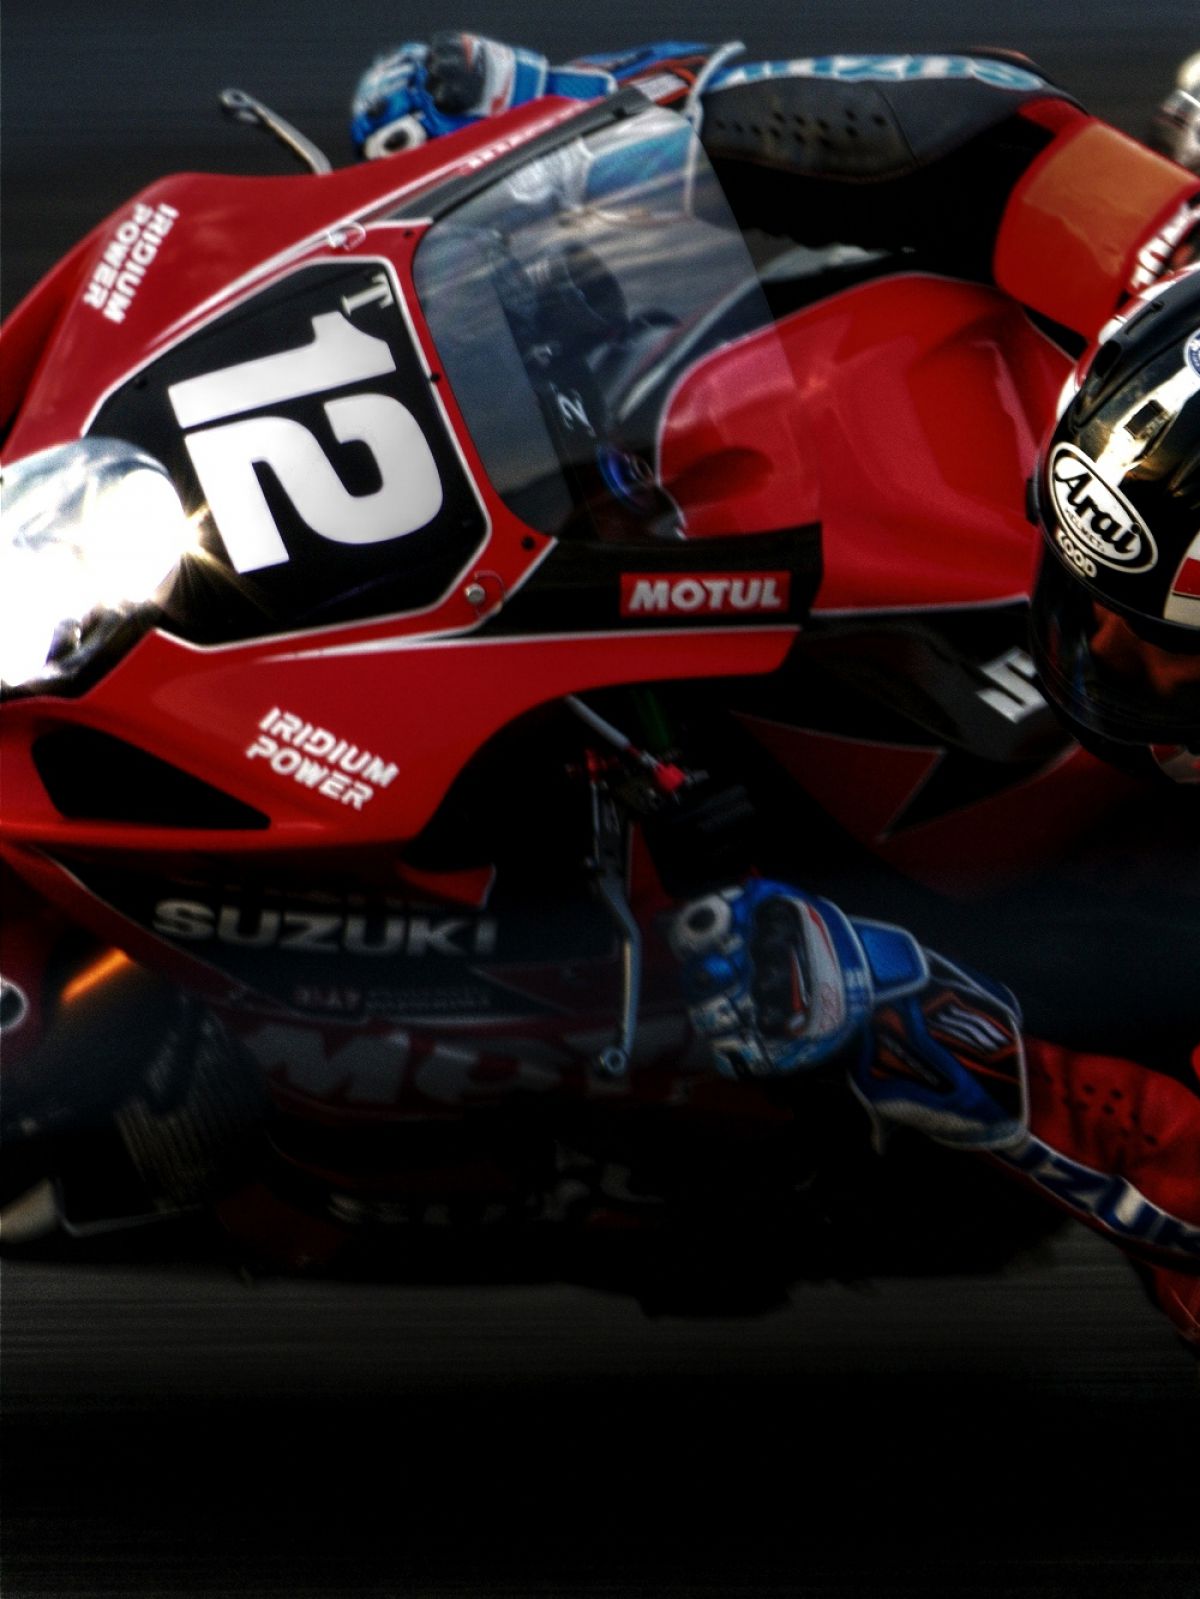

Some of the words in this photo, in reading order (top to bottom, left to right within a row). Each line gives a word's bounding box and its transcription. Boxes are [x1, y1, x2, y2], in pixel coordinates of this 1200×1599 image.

[82, 202, 154, 310] POWER
[102, 202, 180, 325] IRIDIUM
[167, 310, 444, 574] 12
[1054, 470, 1141, 554] Arai
[629, 577, 782, 613] MOTUL
[245, 734, 375, 812] POWER
[258, 705, 400, 789] IRIDIUM
[153, 898, 500, 957] SUZUKI
